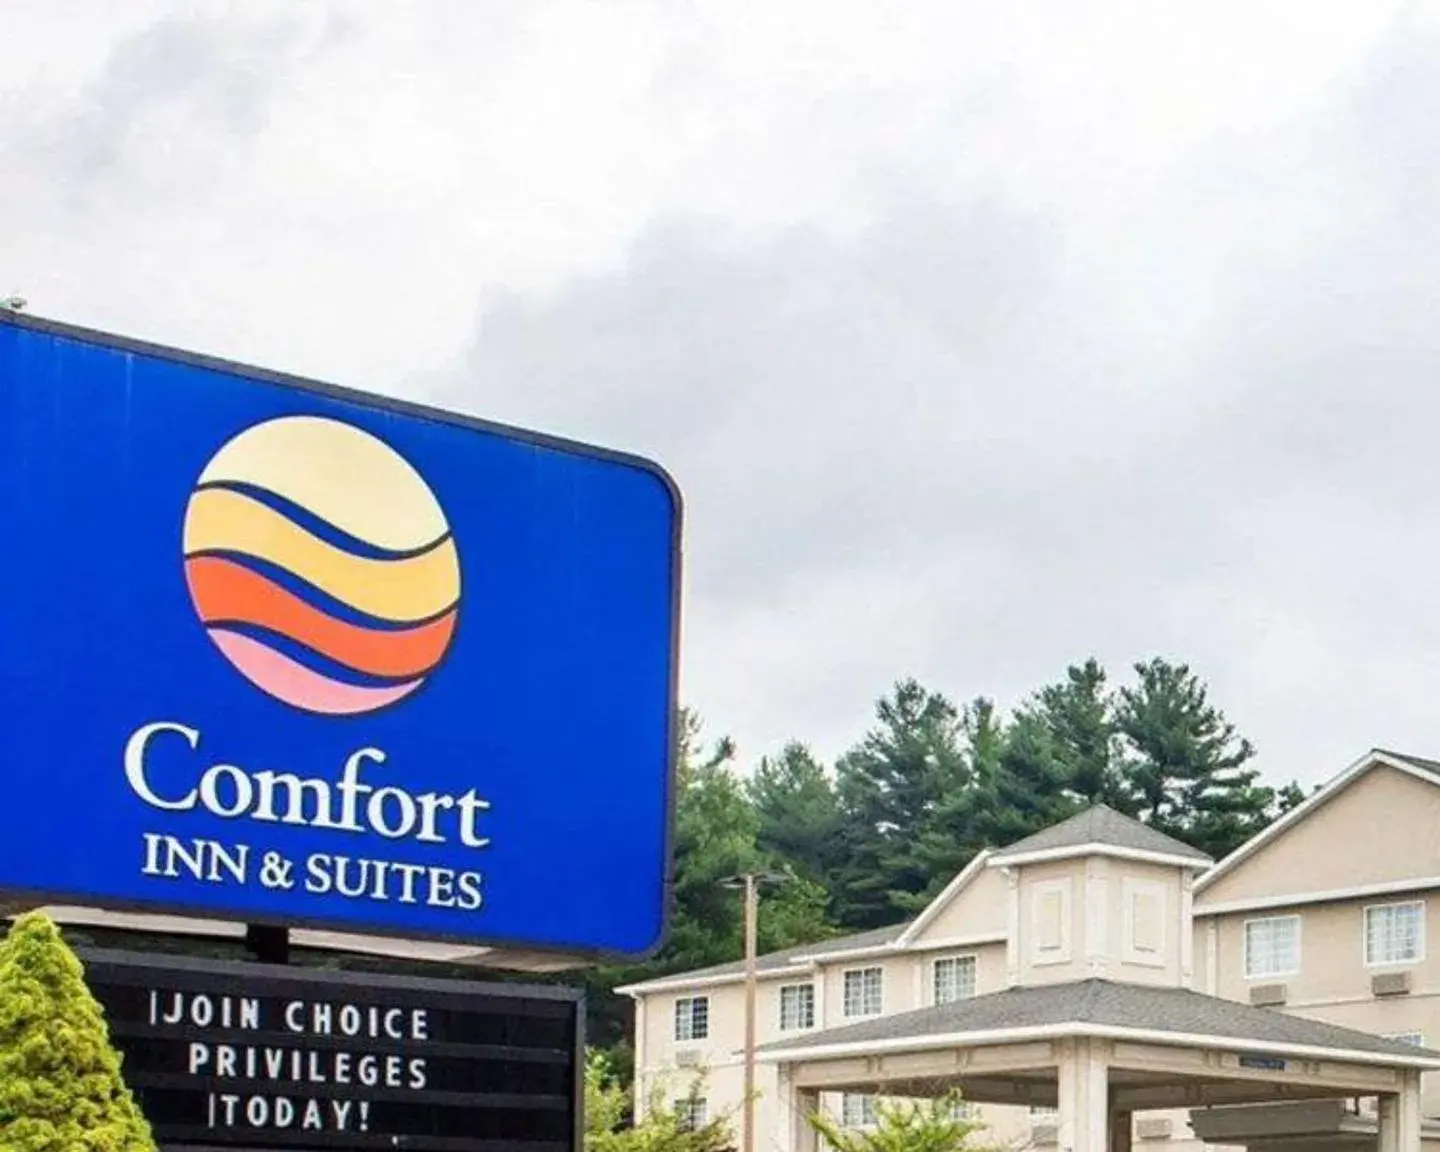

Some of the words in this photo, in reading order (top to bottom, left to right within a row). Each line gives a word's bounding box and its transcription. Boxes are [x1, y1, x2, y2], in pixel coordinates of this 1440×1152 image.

[123, 721, 490, 847] Comfort
[142, 832, 249, 884] INN
[259, 851, 293, 889] &
[304, 853, 483, 911] SUITES
[285, 1001, 428, 1040] CHOICE
[188, 1042, 428, 1090] PRIVILEGES
